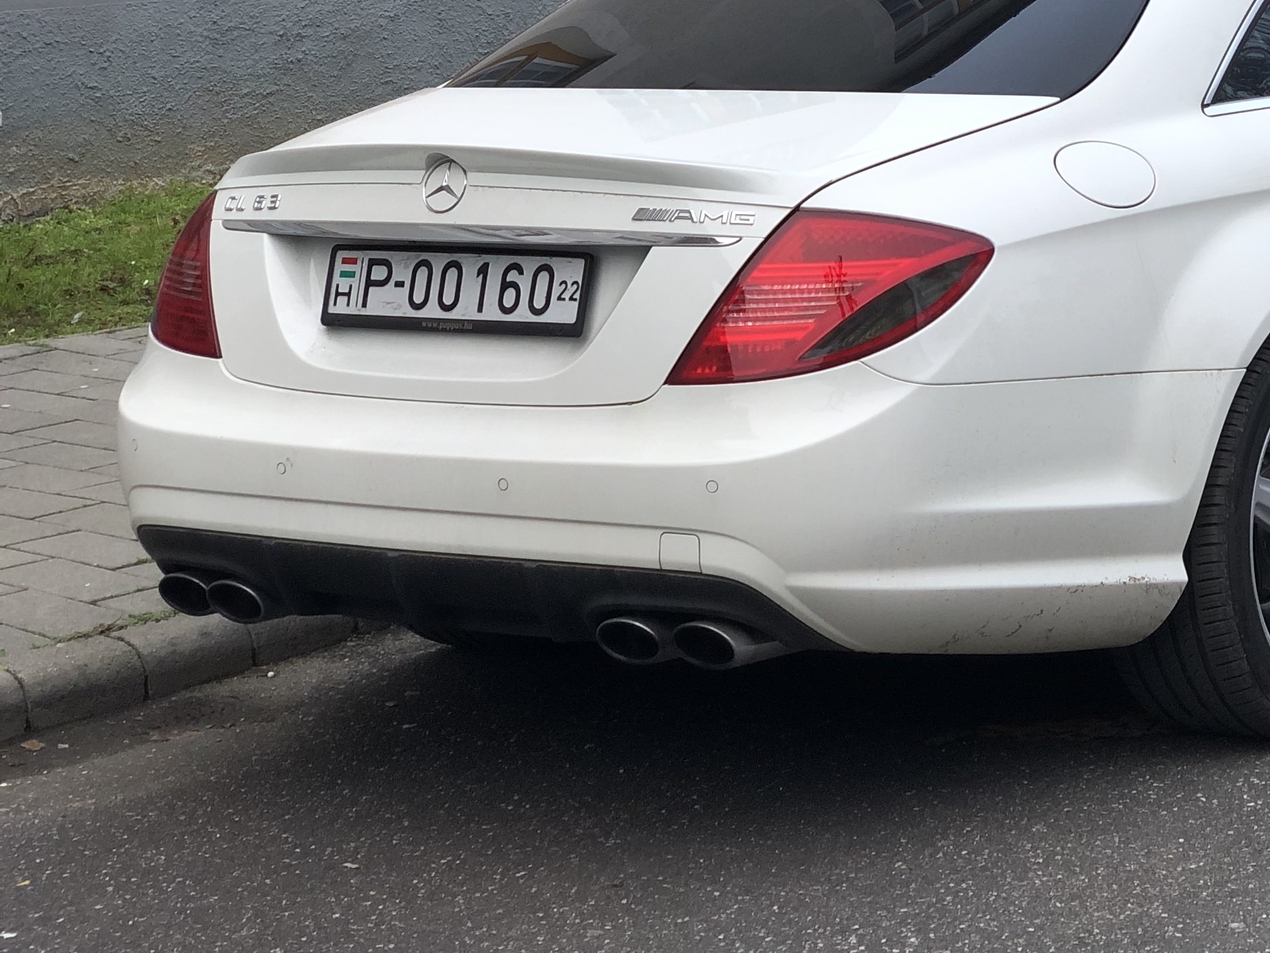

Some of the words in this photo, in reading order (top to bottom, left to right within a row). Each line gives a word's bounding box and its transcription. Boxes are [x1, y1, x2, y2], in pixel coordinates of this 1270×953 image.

[224, 195, 245, 211] CL
[252, 194, 281, 211] 63
[669, 209, 756, 226] AMG
[333, 283, 353, 308] H
[361, 257, 556, 317] P-00160
